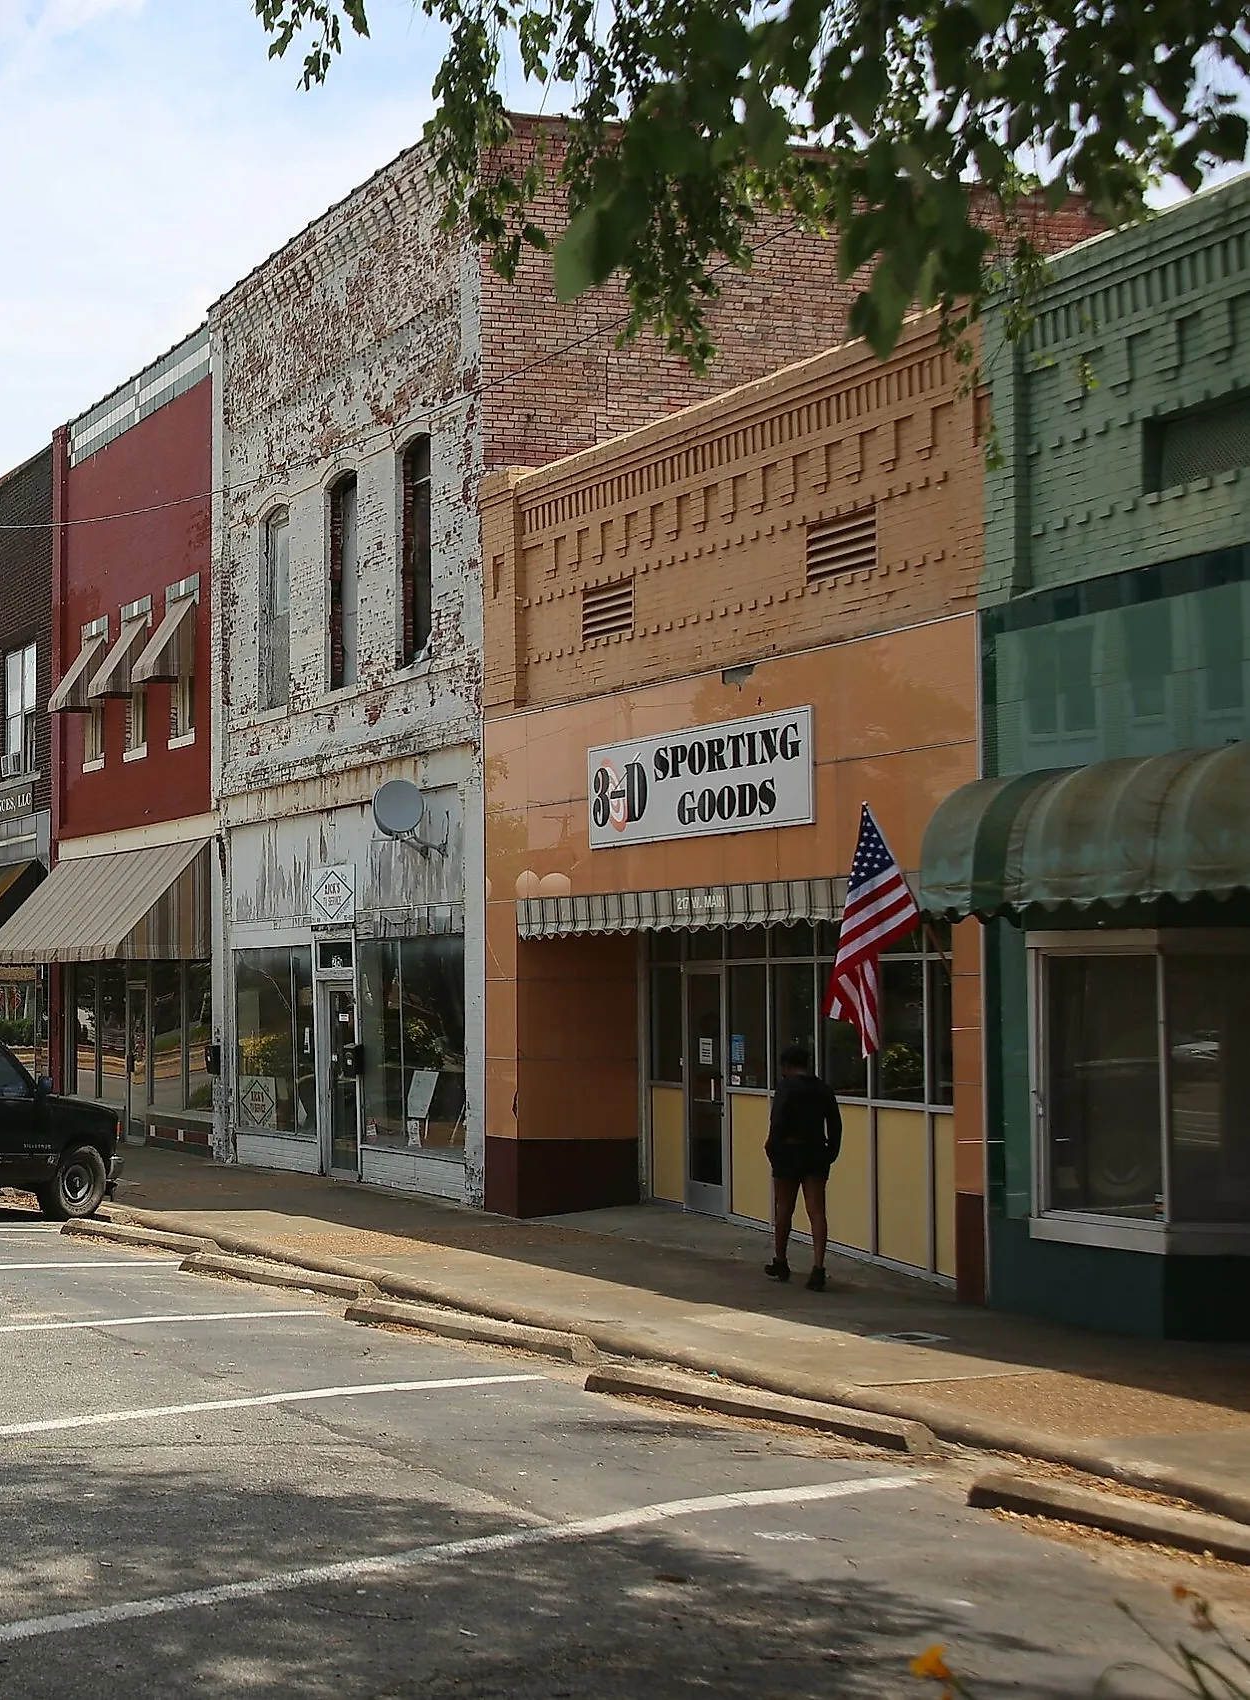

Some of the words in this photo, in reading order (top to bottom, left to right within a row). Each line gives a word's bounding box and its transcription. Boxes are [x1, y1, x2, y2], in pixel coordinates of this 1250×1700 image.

[653, 721, 802, 782] SPORTING
[17, 792, 32, 808] LLC
[592, 761, 648, 828] 3-D
[676, 777, 777, 826] GOODS
[704, 894, 725, 908] MAIN
